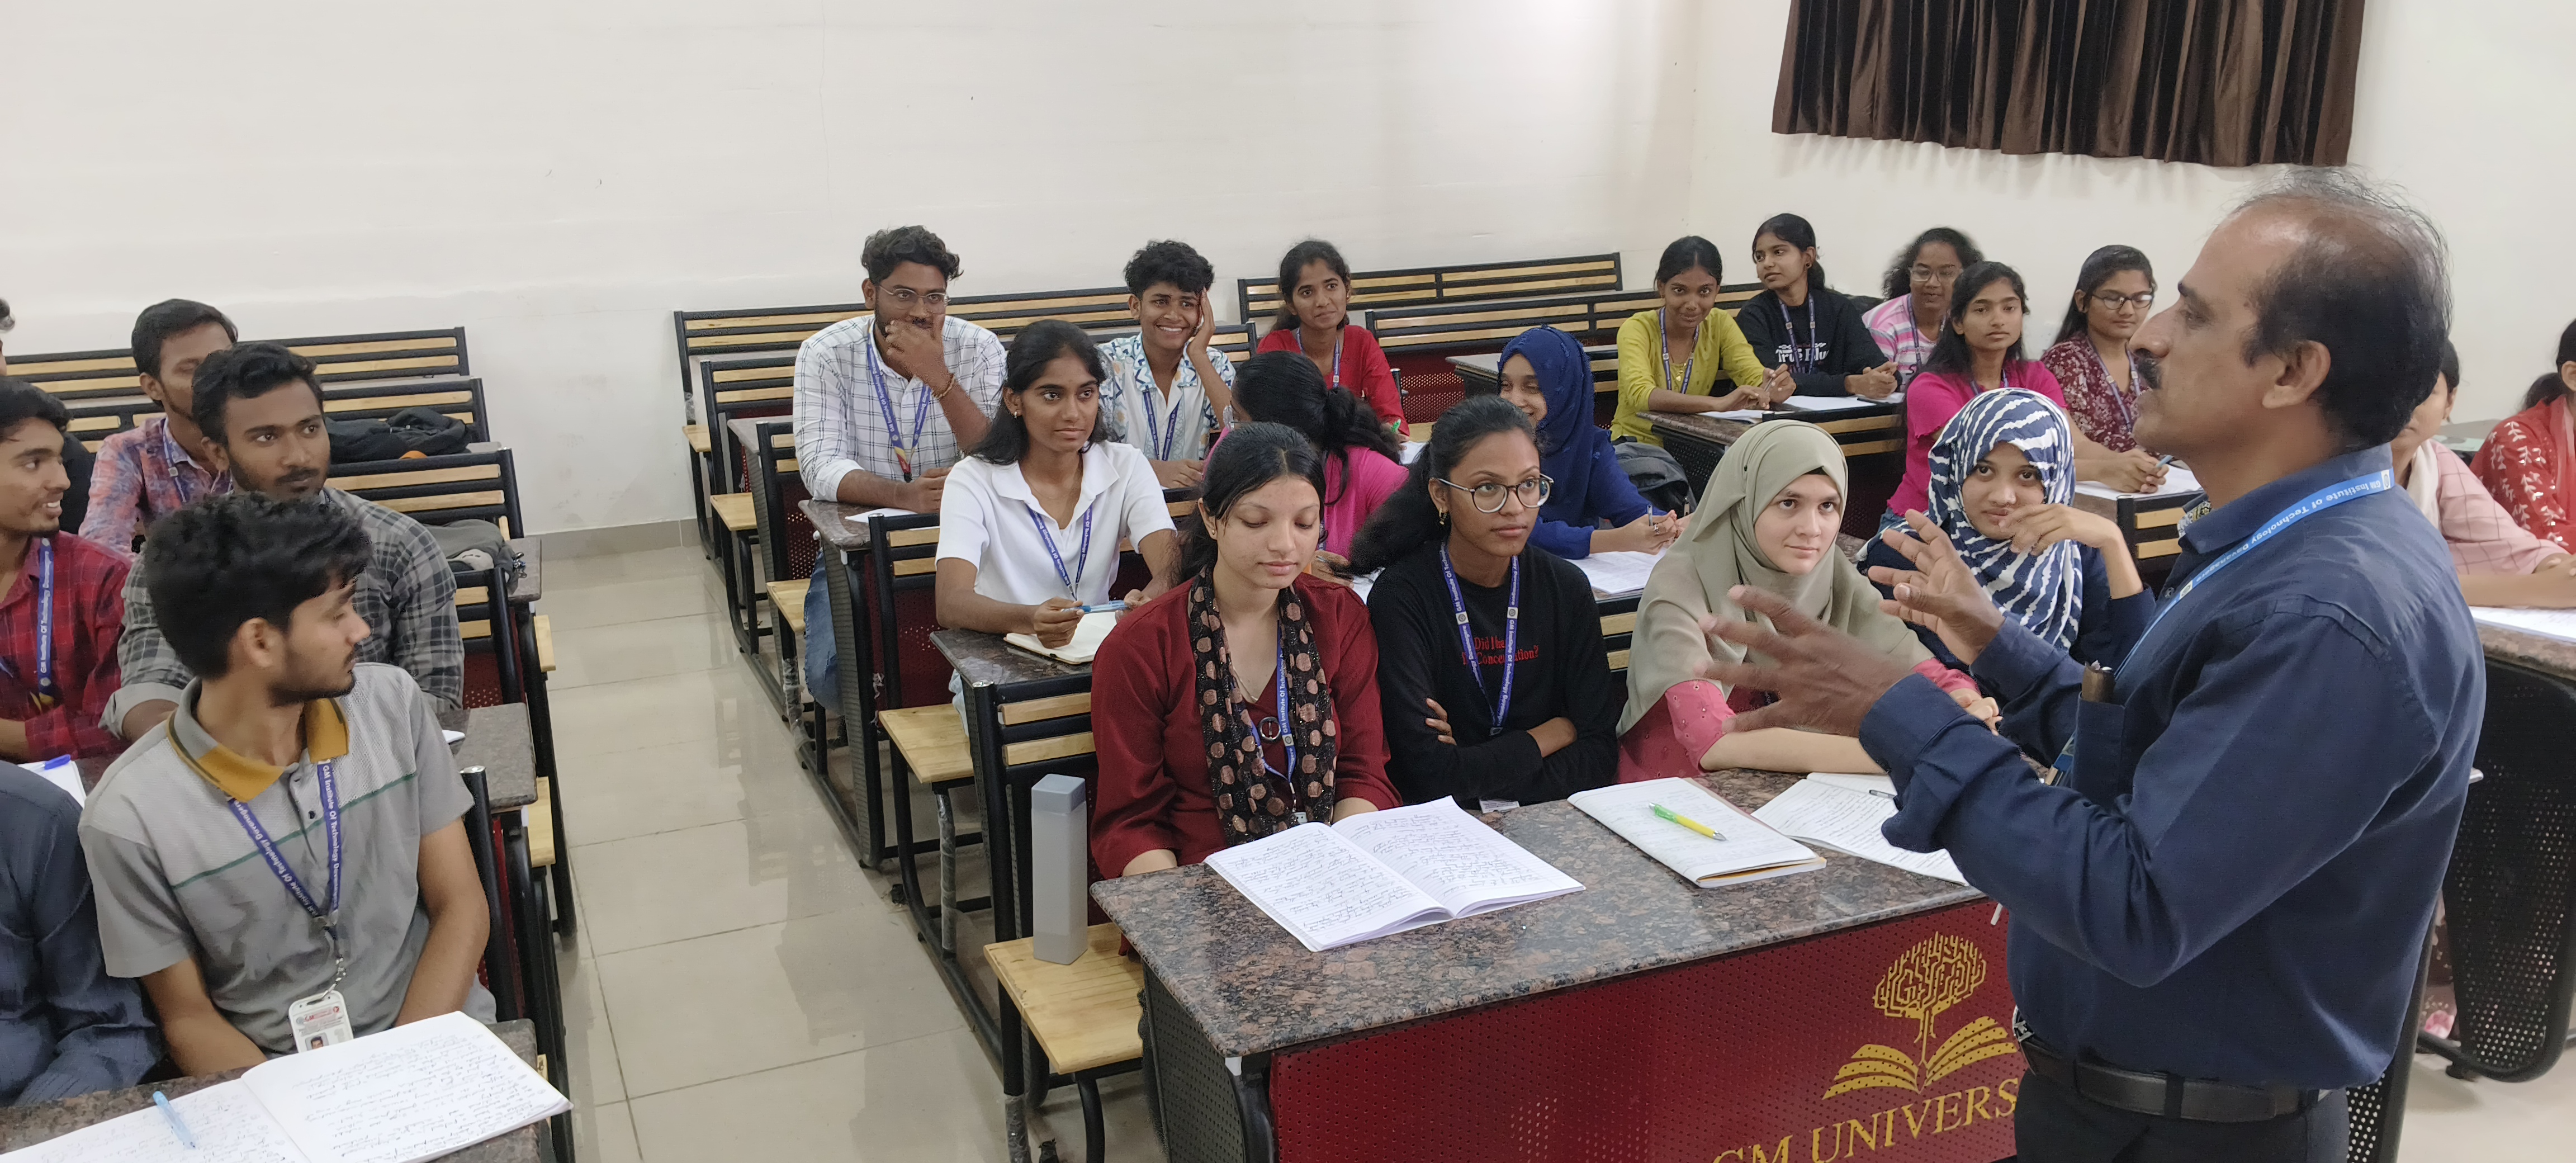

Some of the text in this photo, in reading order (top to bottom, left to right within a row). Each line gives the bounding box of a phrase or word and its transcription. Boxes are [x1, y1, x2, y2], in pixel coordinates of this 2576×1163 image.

[2325, 481, 2370, 502] Institute
[2251, 505, 2310, 544] Technology
[1474, 636, 1490, 651] Did
